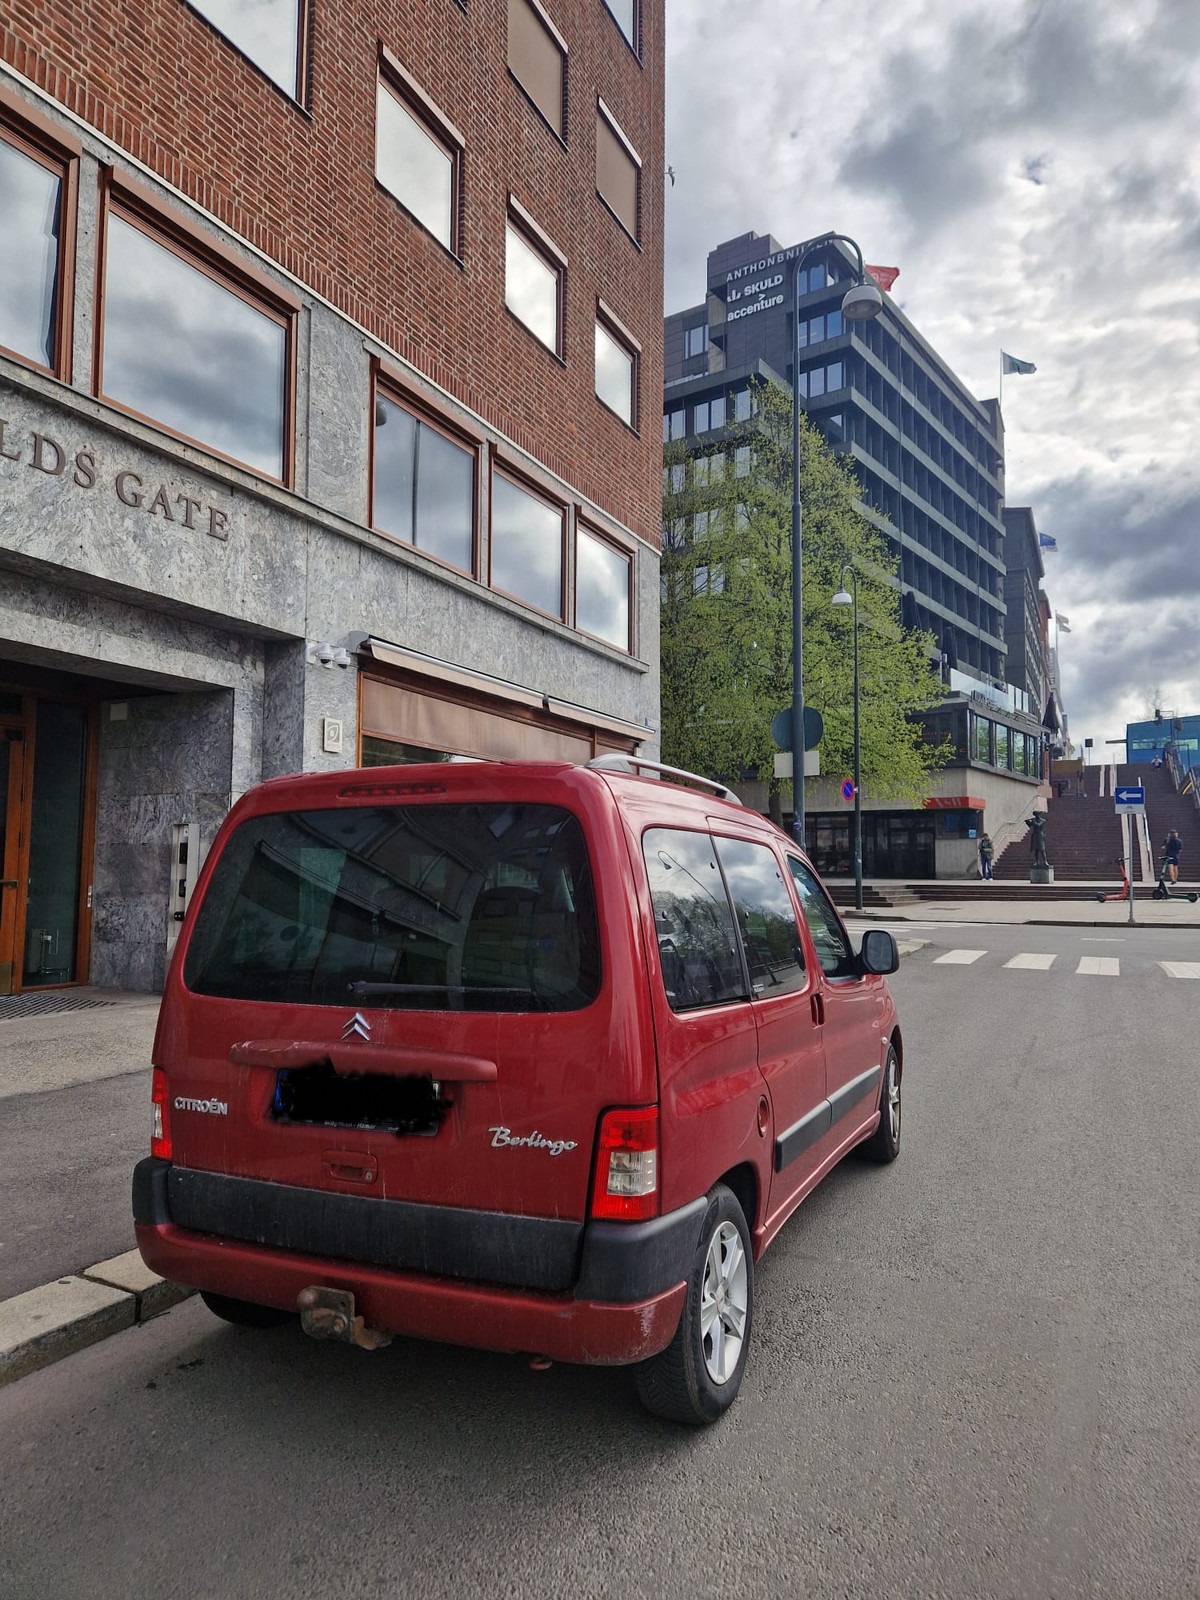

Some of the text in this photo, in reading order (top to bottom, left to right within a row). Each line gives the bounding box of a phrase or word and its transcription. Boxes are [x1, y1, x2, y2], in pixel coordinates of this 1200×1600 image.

[744, 274, 783, 296] SKULD
[727, 293, 784, 321] accenture
[115, 470, 229, 541] GATE
[174, 1096, 228, 1115] CITROËN
[488, 1126, 578, 1156] Berlingo
